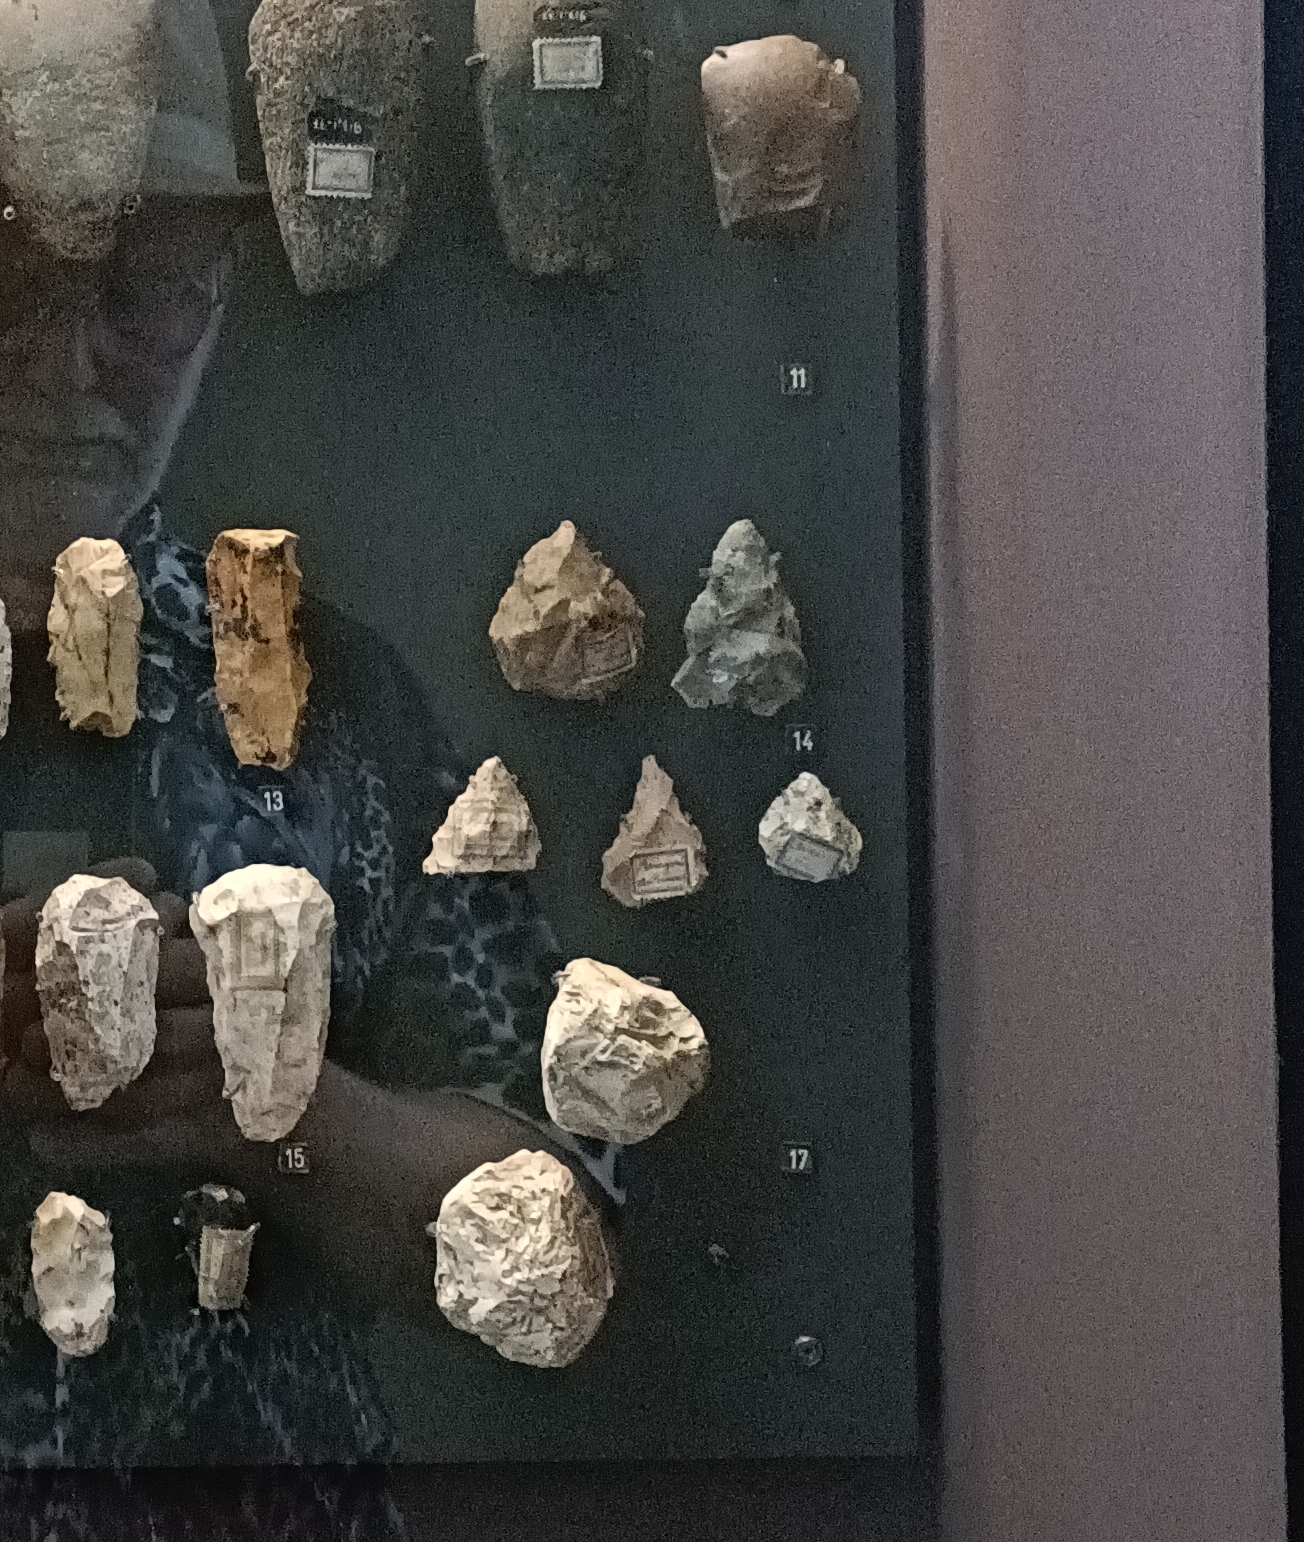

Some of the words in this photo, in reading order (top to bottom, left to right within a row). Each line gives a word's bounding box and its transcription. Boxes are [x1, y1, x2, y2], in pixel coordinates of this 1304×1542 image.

[790, 368, 806, 389] 11
[793, 730, 813, 751] 14
[264, 791, 284, 811] 13
[286, 1148, 305, 1168] 15
[790, 1149, 809, 1170] 17
